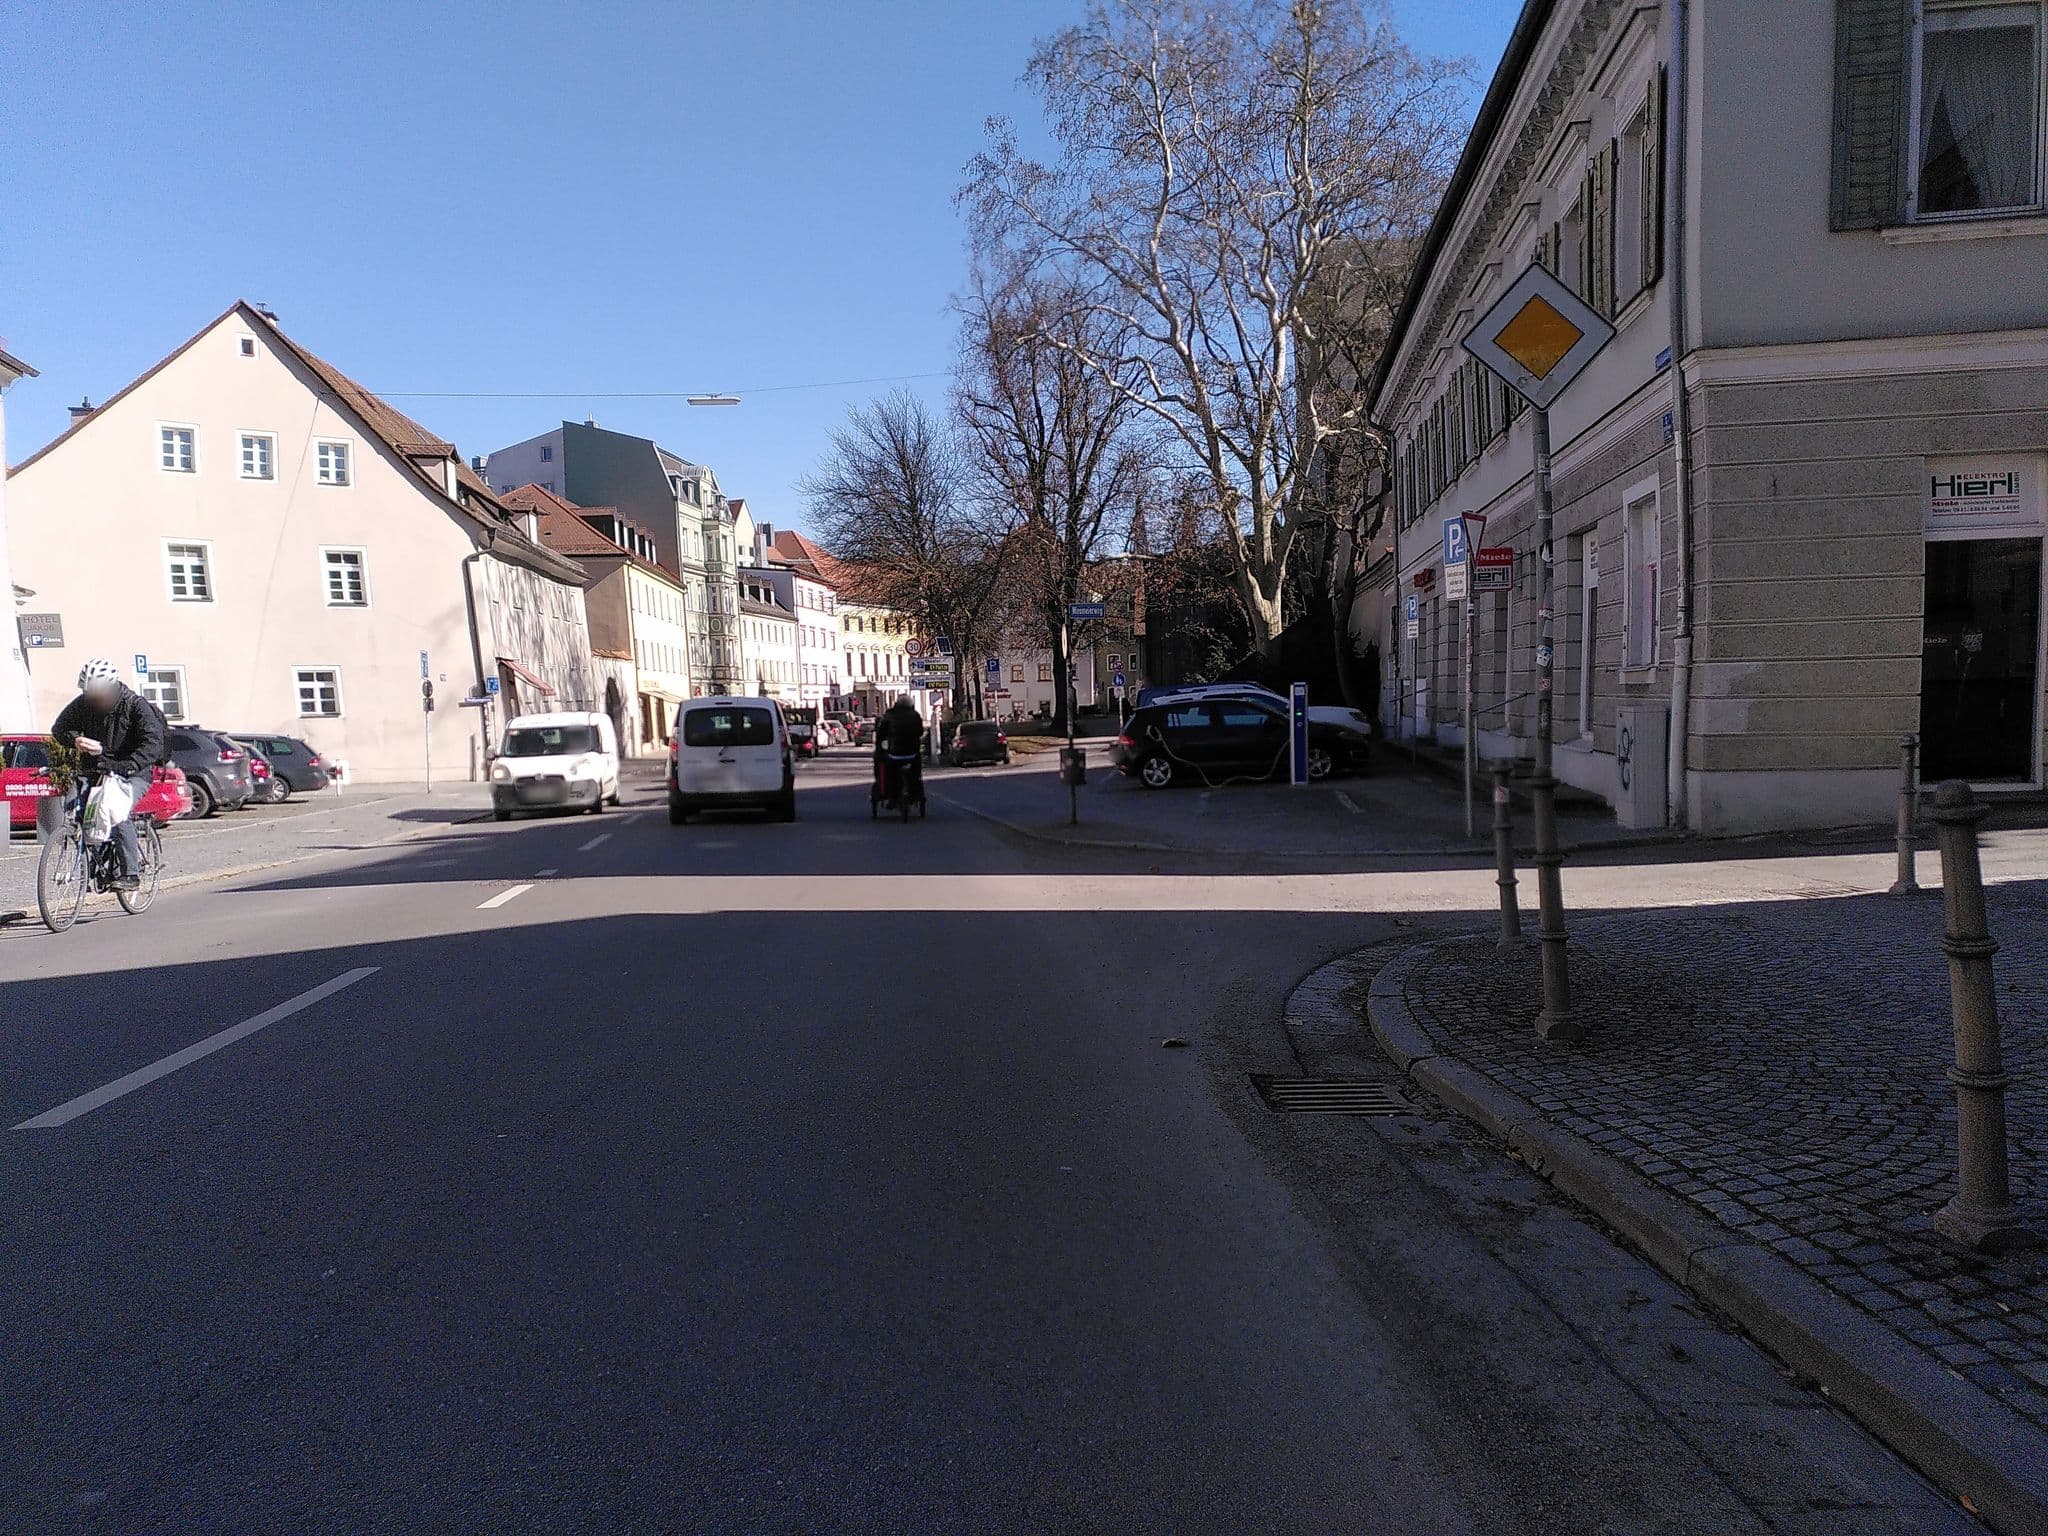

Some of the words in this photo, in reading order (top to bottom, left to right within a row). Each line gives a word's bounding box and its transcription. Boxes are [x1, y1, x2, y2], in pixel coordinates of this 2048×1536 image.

[1963, 472, 2006, 480] ELEKTRO
[1931, 472, 2013, 498] Hierl
[1449, 523, 1462, 559] P
[1479, 553, 1512, 562] Miele
[23, 615, 58, 624] HOTEL
[908, 643, 919, 651] 30
